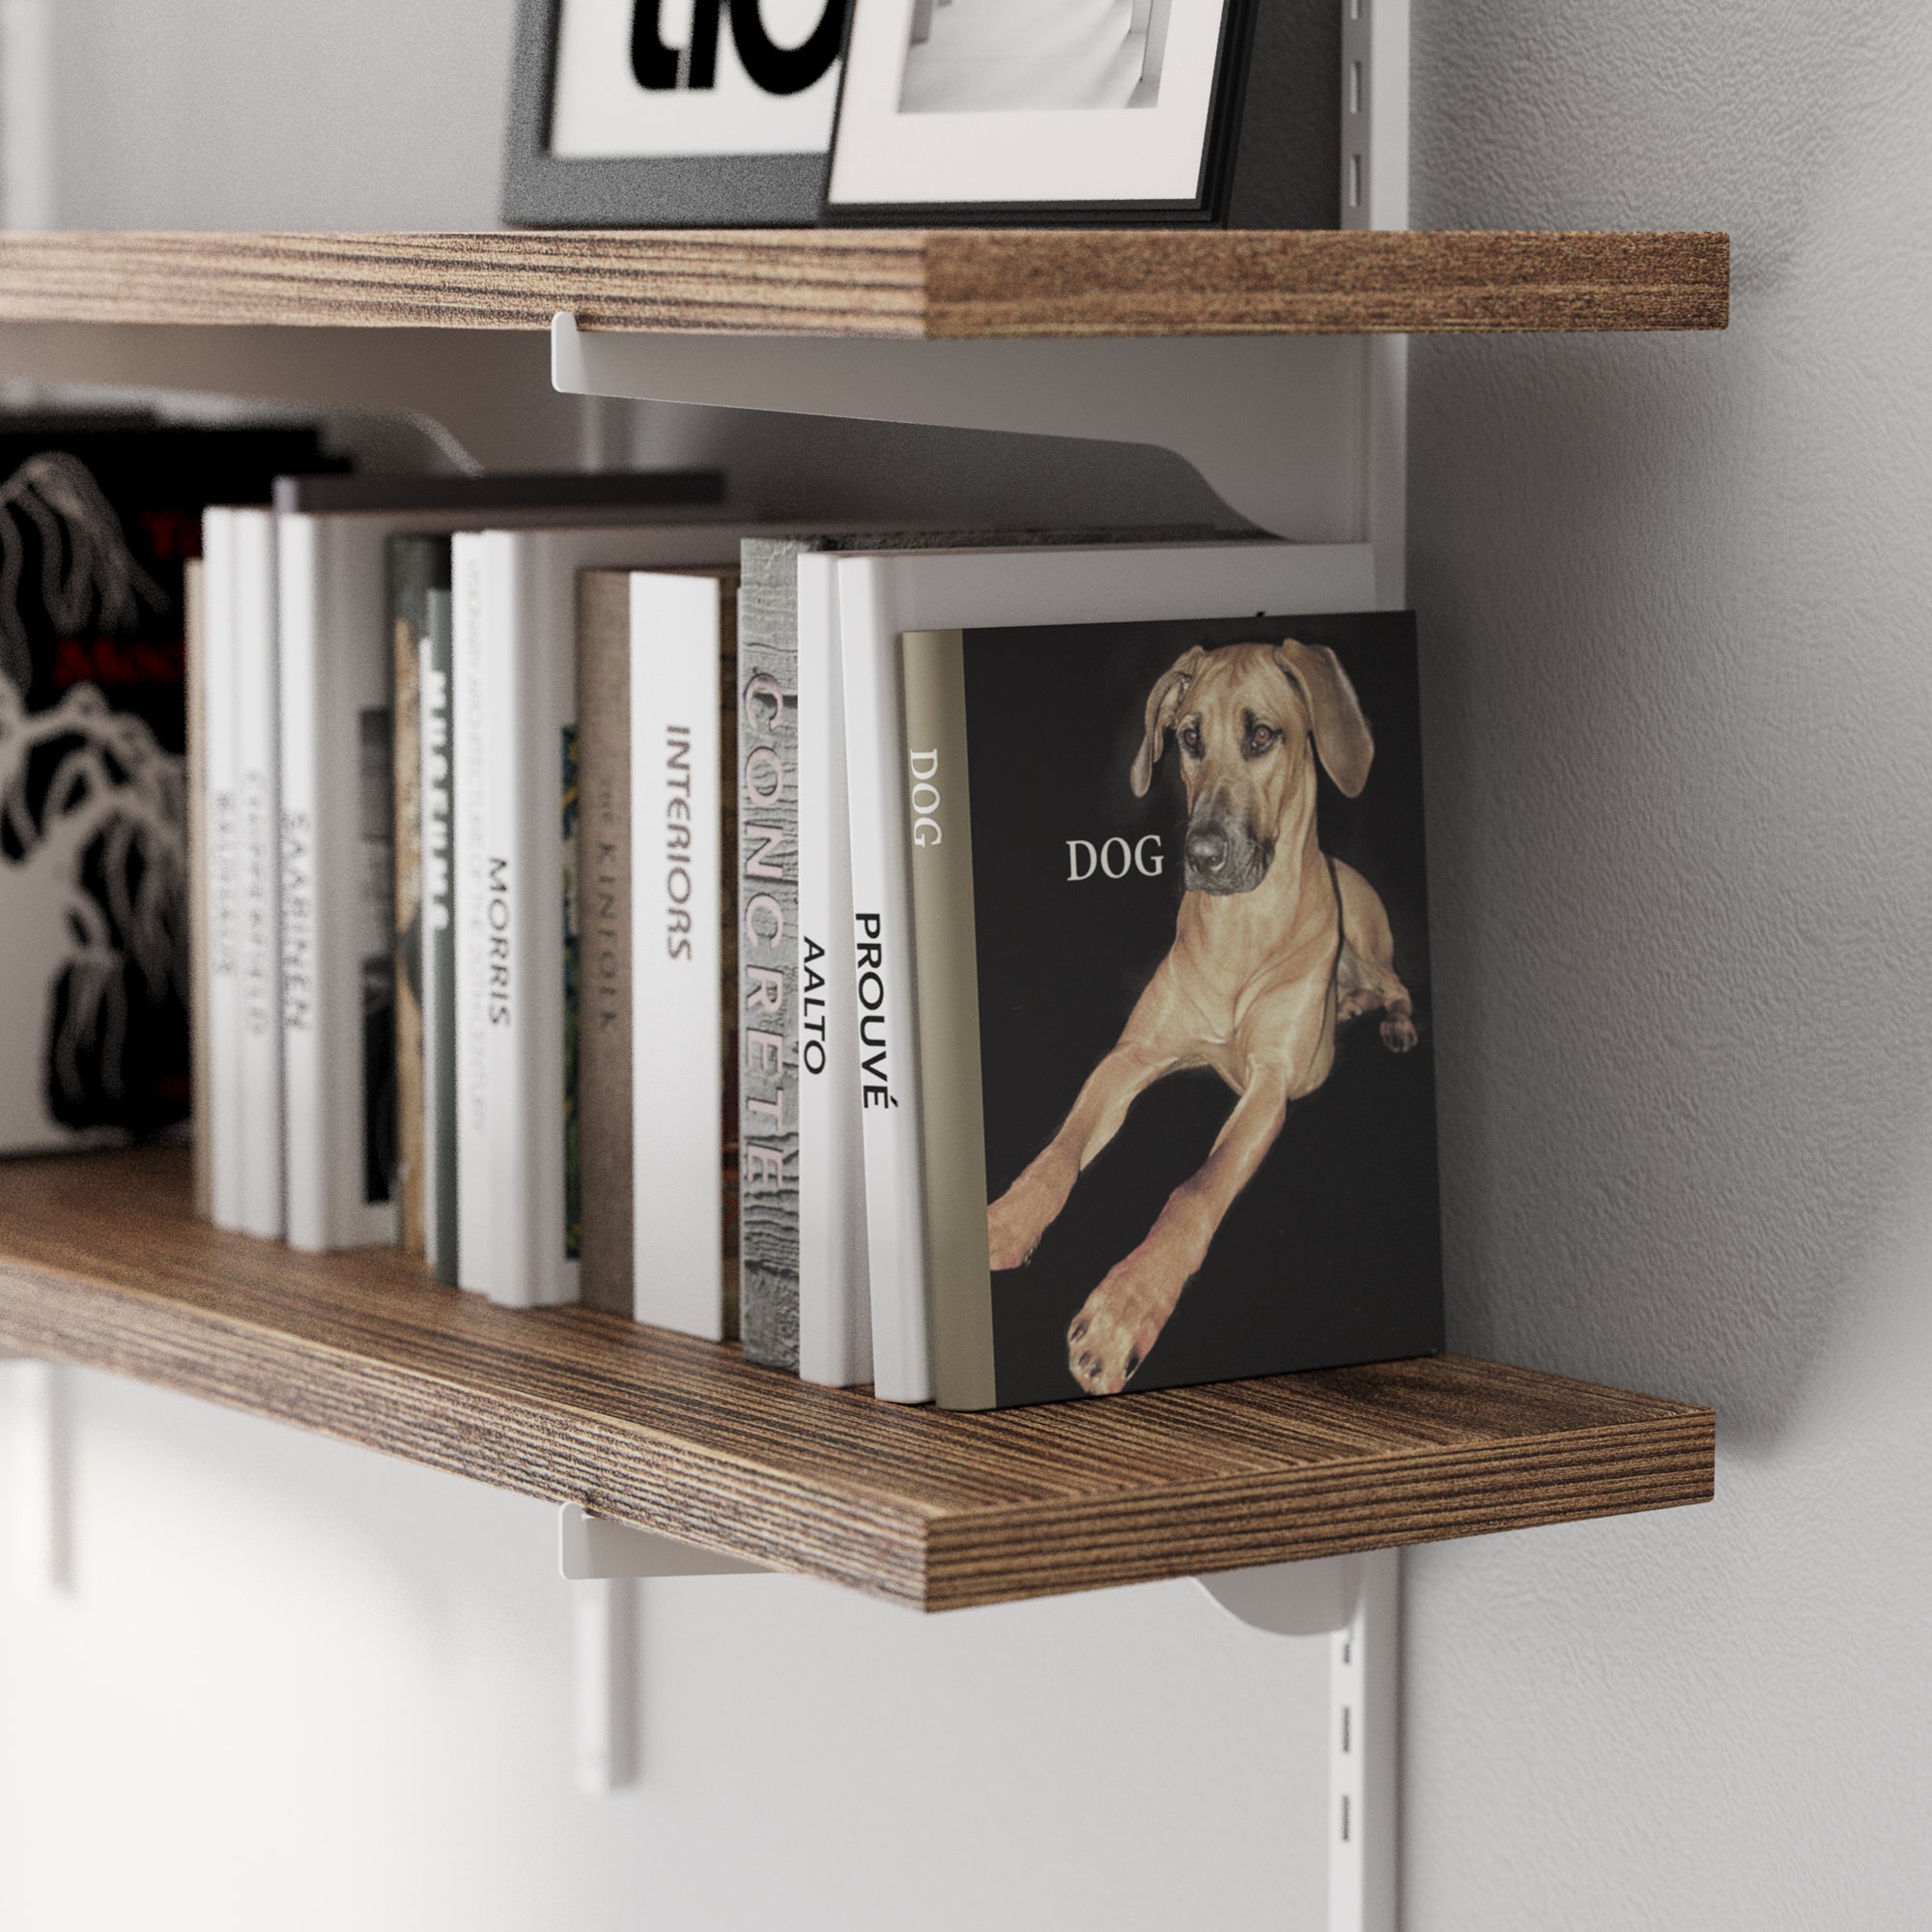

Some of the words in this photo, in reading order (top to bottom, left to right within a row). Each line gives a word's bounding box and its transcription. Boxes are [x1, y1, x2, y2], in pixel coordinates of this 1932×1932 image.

[664, 724, 693, 962] INTERIORS
[909, 748, 942, 848] DOG
[1065, 834, 1165, 882] DOG
[284, 810, 312, 1031] SAARINEN
[487, 855, 512, 1030] MORRIS
[744, 669, 786, 1190] CONCRETE
[802, 935, 828, 1076] AALTO
[854, 912, 898, 1110] PROUVÉ
